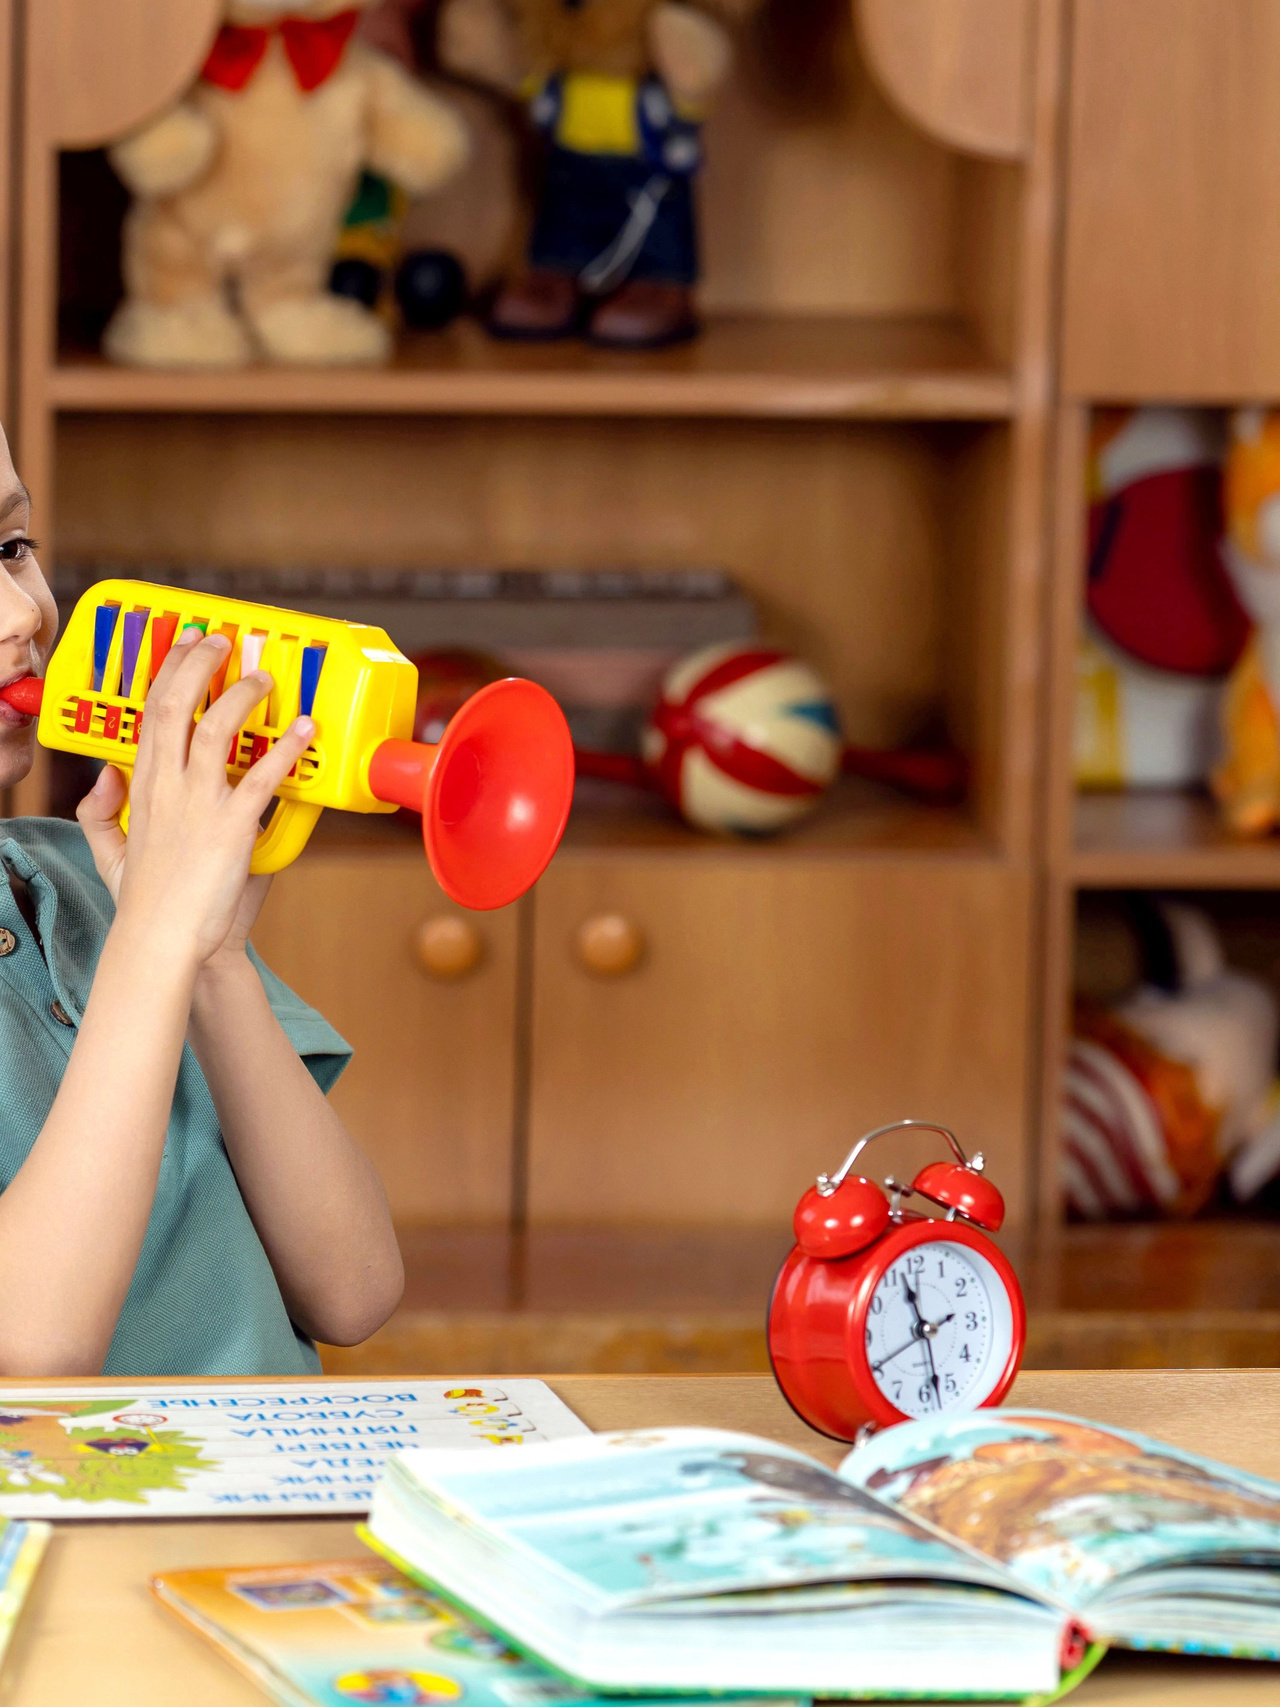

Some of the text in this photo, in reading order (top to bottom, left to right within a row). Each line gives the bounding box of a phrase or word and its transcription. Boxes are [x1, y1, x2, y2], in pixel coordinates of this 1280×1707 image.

[108, 716, 116, 729] 2
[906, 1255, 926, 1275] 12
[937, 1260, 946, 1278] 1
[955, 1278, 967, 1298] 2
[870, 1296, 883, 1315] 0
[965, 1311, 978, 1331] 3
[959, 1343, 971, 1363] 4
[891, 1380, 904, 1400] 7
[944, 1373, 957, 1392] 5
[149, 1393, 419, 1408] ВОСКРЕСЕНЬЕ
[918, 1384, 931, 1404] 6
[226, 1409, 405, 1422] СУББОТА
[229, 1424, 419, 1438] ПЯТНИЦА
[269, 1441, 420, 1454] ЧЕТВЕРГ
[290, 1457, 385, 1470] ЕДА
[269, 1473, 383, 1487] РНИК
